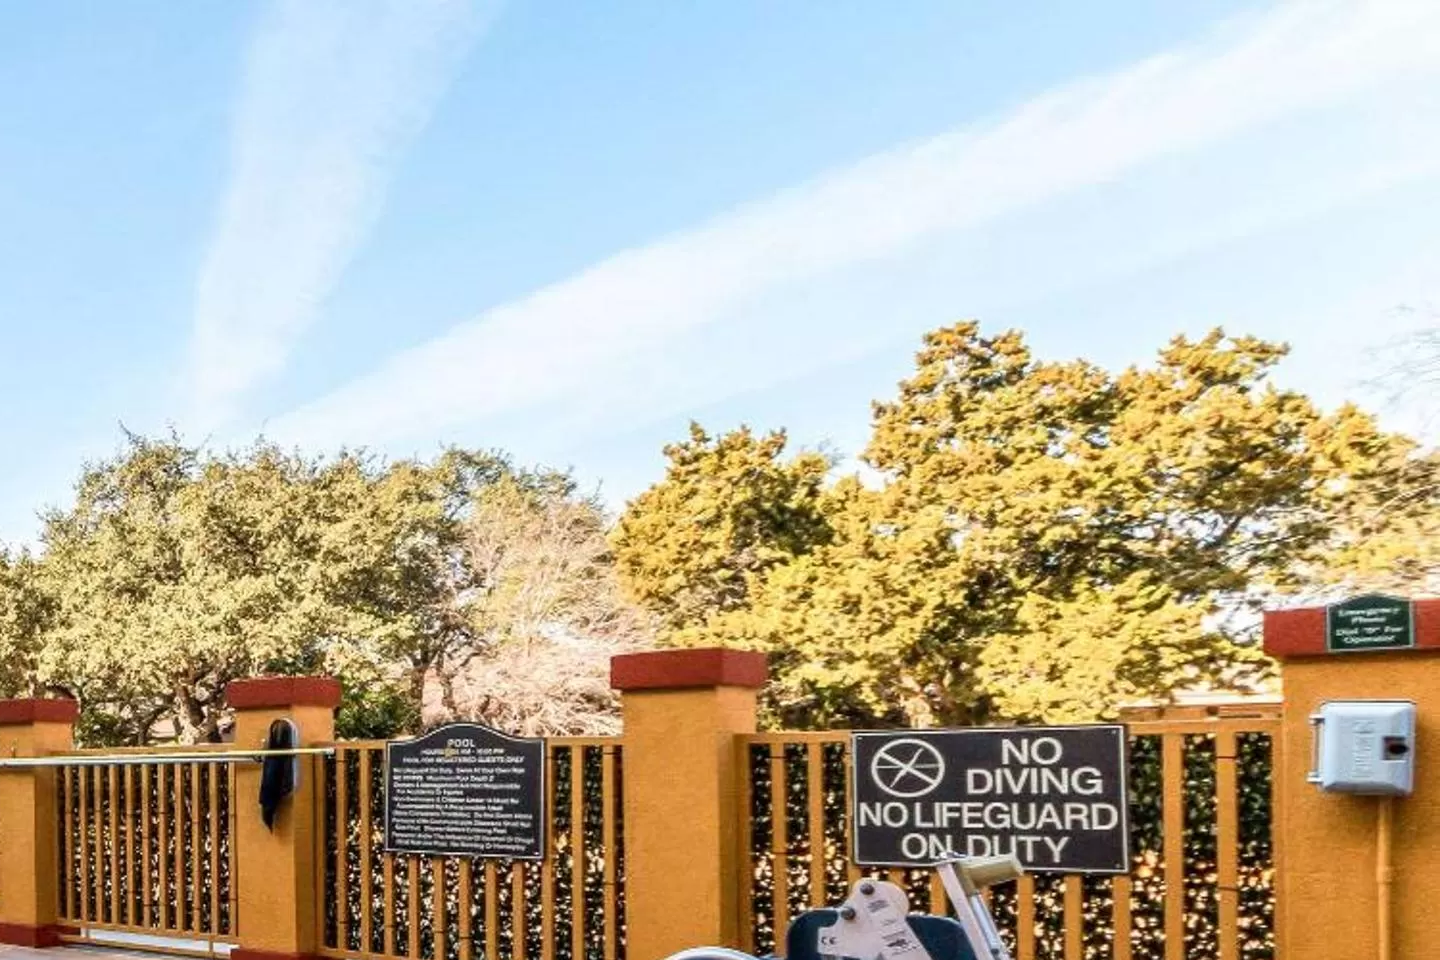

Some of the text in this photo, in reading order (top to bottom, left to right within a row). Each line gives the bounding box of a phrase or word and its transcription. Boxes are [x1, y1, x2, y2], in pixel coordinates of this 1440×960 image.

[447, 739, 476, 747] POOL
[1002, 737, 1063, 765] NO
[967, 767, 1103, 795] DIVING
[859, 802, 1118, 830] NO LIFEGUARD
[901, 833, 1069, 863] ON DUTY
